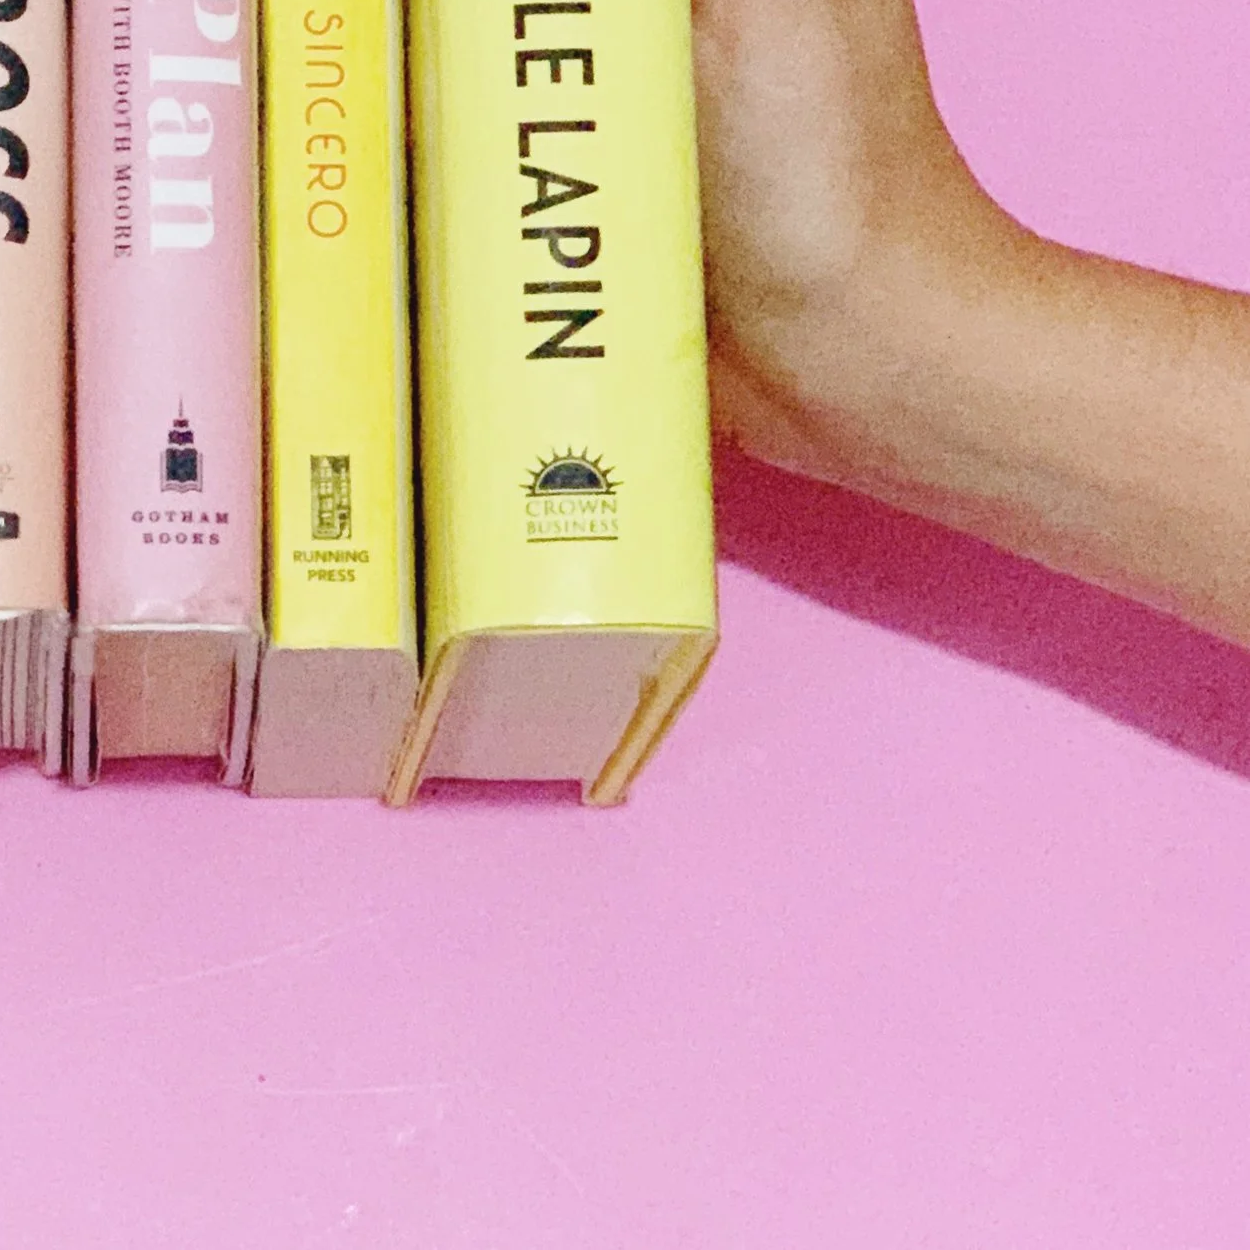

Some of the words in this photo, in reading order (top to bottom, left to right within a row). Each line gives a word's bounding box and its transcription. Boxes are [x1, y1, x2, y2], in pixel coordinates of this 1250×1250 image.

[113, 62, 132, 153] BOOTH
[303, 9, 348, 240] SINCERO
[113, 164, 133, 259] MOORE
[517, 120, 606, 361] LAPIN
[525, 498, 617, 517] CROWN
[131, 510, 229, 524] GOTHAM
[526, 518, 619, 535] BUSINESS
[142, 532, 220, 545] BOOKS
[293, 550, 370, 563] RUNNING
[307, 569, 356, 582] PRESS
